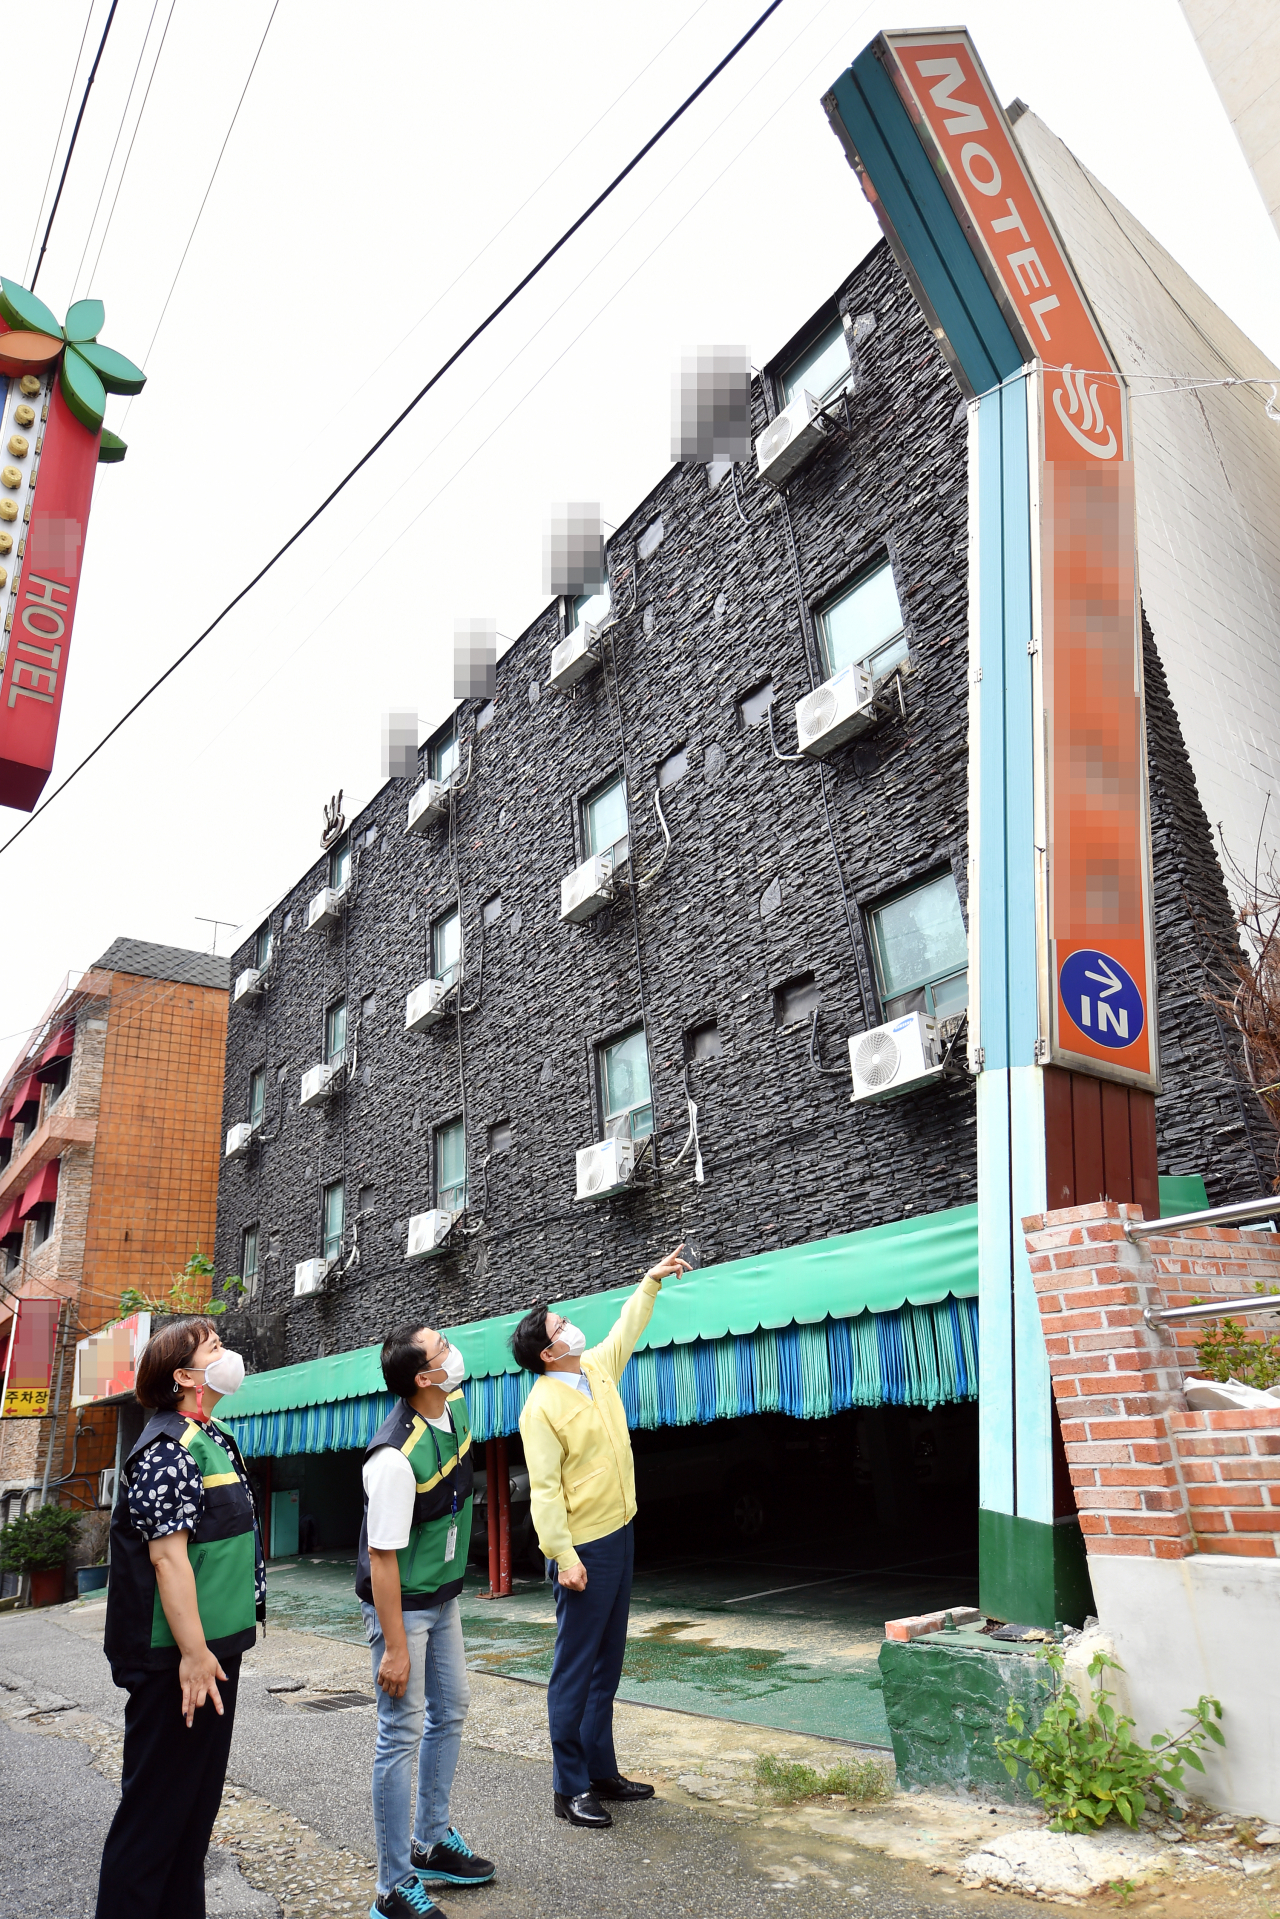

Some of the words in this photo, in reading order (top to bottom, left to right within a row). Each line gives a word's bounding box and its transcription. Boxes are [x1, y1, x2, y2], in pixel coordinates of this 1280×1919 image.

[915, 57, 1061, 341] MOTEL
[7, 573, 71, 708] HOTEL
[1080, 995, 1129, 1039] IN
[5, 1390, 48, 1404] 주차장
